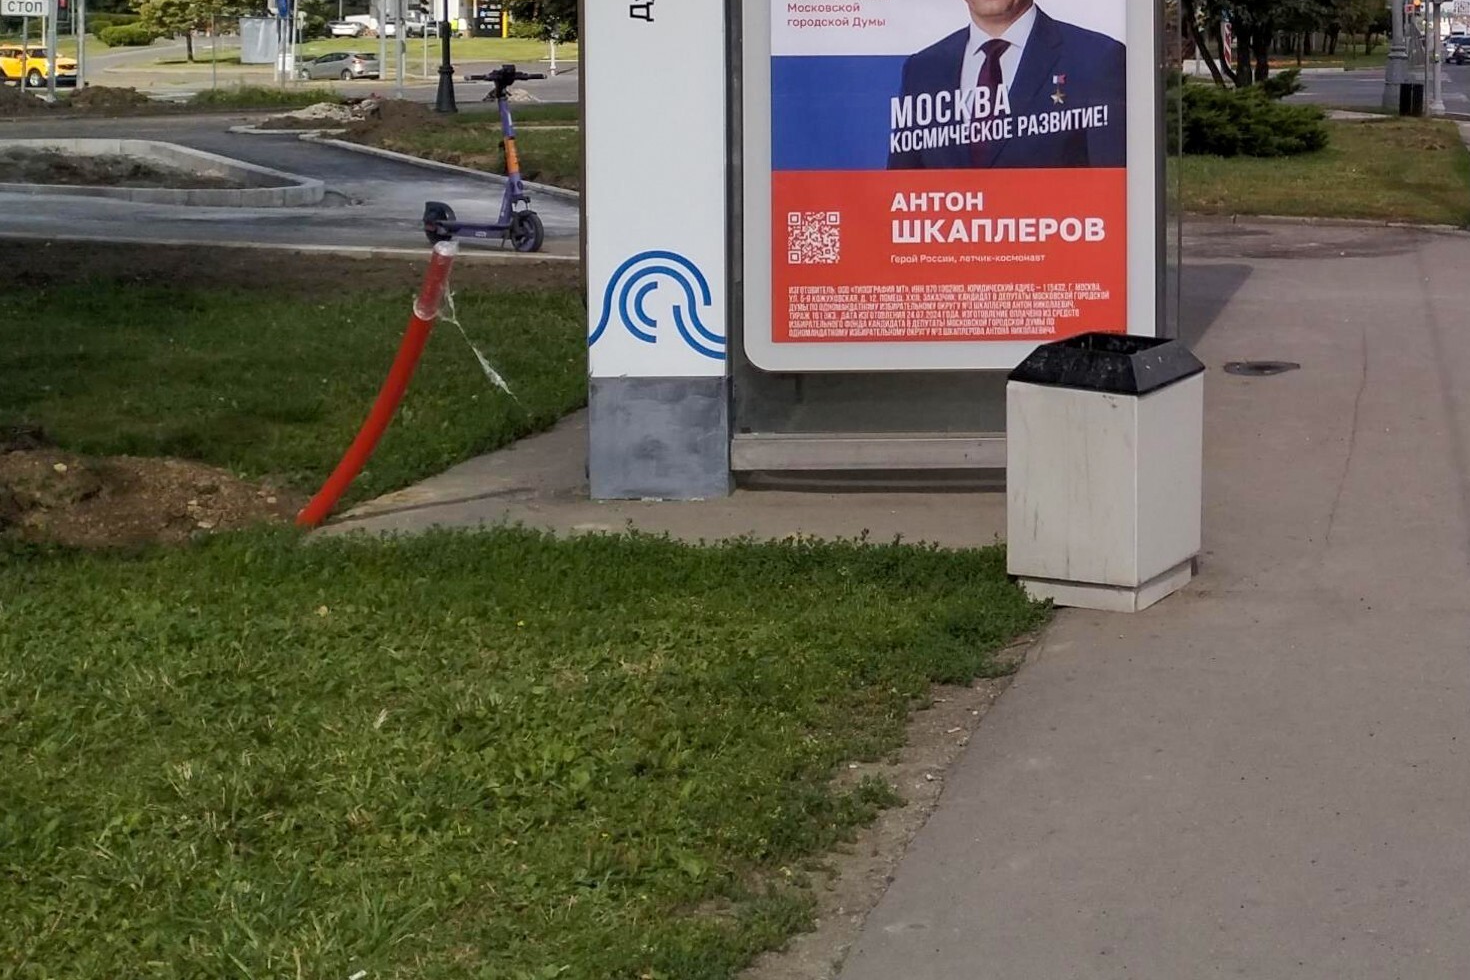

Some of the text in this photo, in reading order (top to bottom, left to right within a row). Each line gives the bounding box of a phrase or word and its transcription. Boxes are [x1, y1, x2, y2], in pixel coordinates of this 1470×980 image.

[7, 0, 43, 13] СТОП
[787, 2, 860, 13] Московской
[787, 16, 886, 28] городской Думы
[890, 83, 1011, 129] МОСКВА
[890, 105, 1108, 154] КОСМИЧЕСКОЕ РАЗВИТИЕ!
[890, 192, 984, 212] АНТОН
[892, 218, 1106, 244] ШКАПЛЕРОВ
[890, 254, 918, 264] Герой
[920, 254, 957, 264] России,
